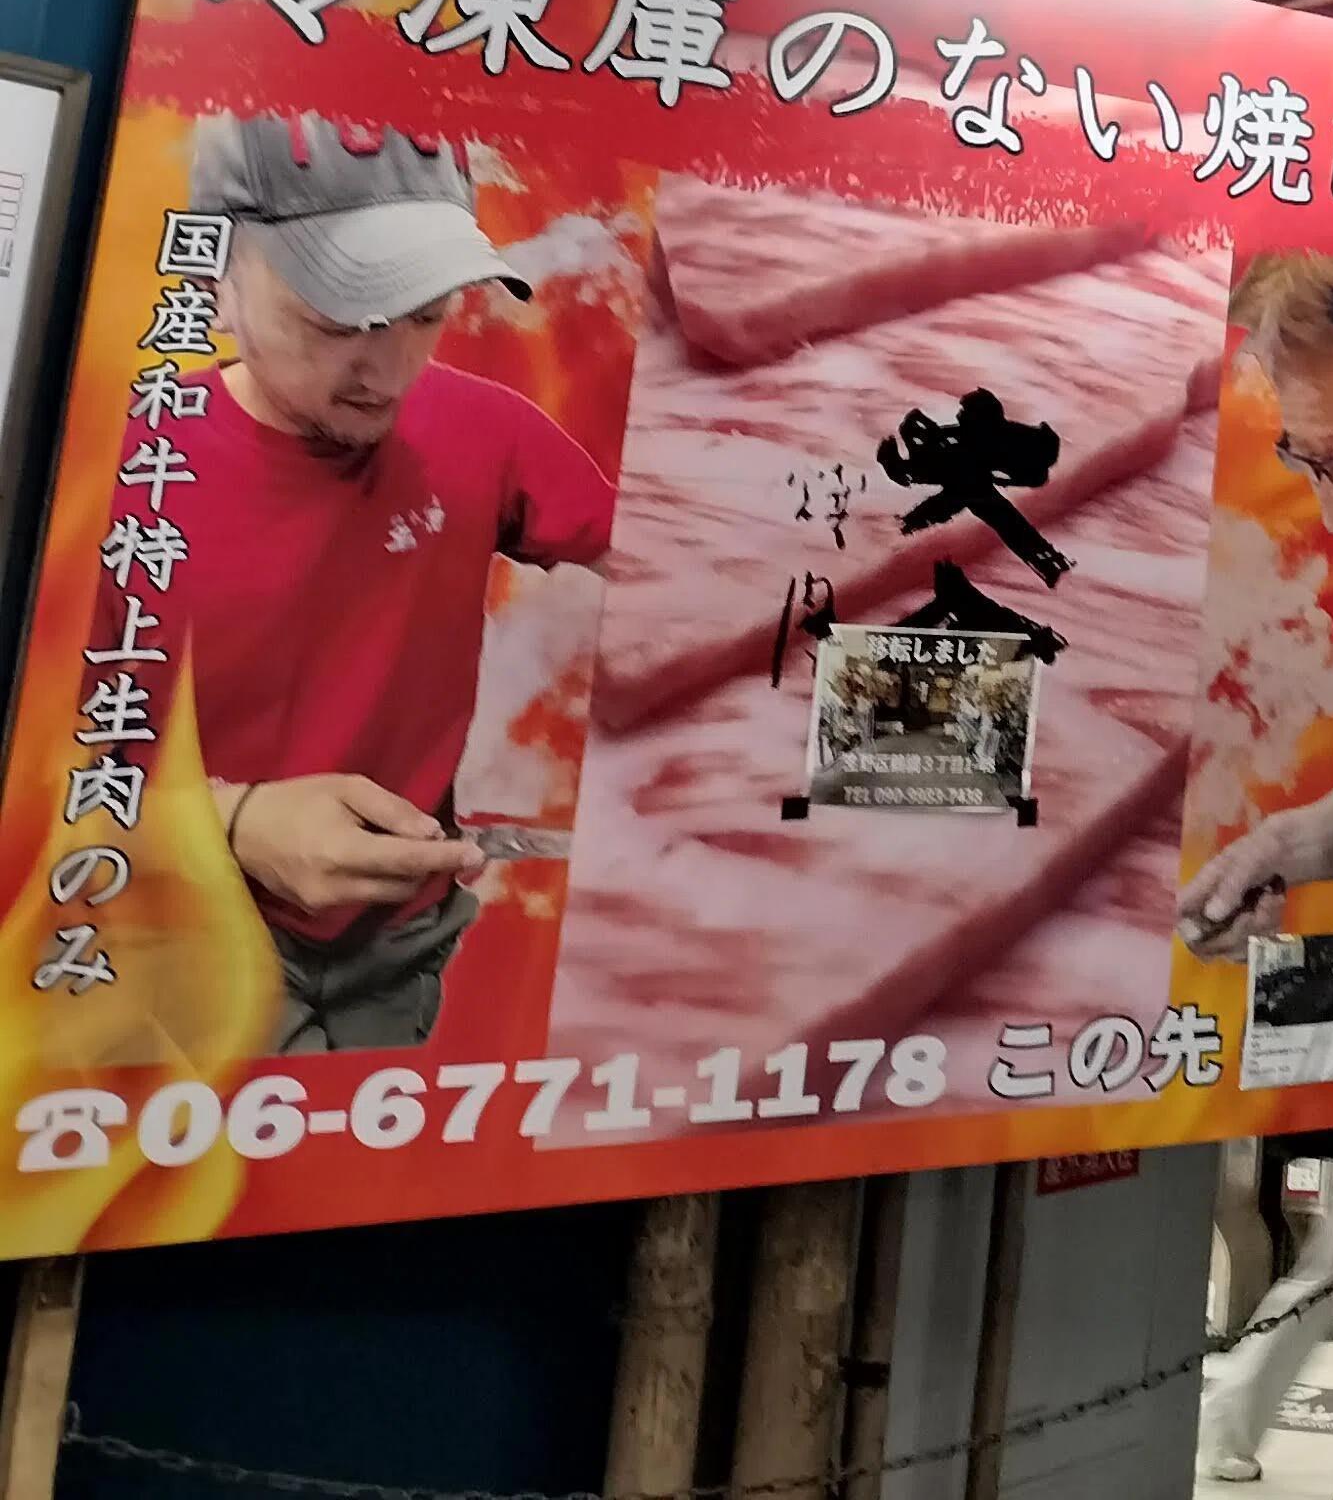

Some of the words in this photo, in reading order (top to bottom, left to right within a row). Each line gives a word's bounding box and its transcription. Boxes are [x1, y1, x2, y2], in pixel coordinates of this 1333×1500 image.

[32, 211, 234, 995] 国産和牛特上生肉のみ
[137, 1034, 947, 1167] 06-6771-1178
[988, 1007, 1222, 1100] この先
